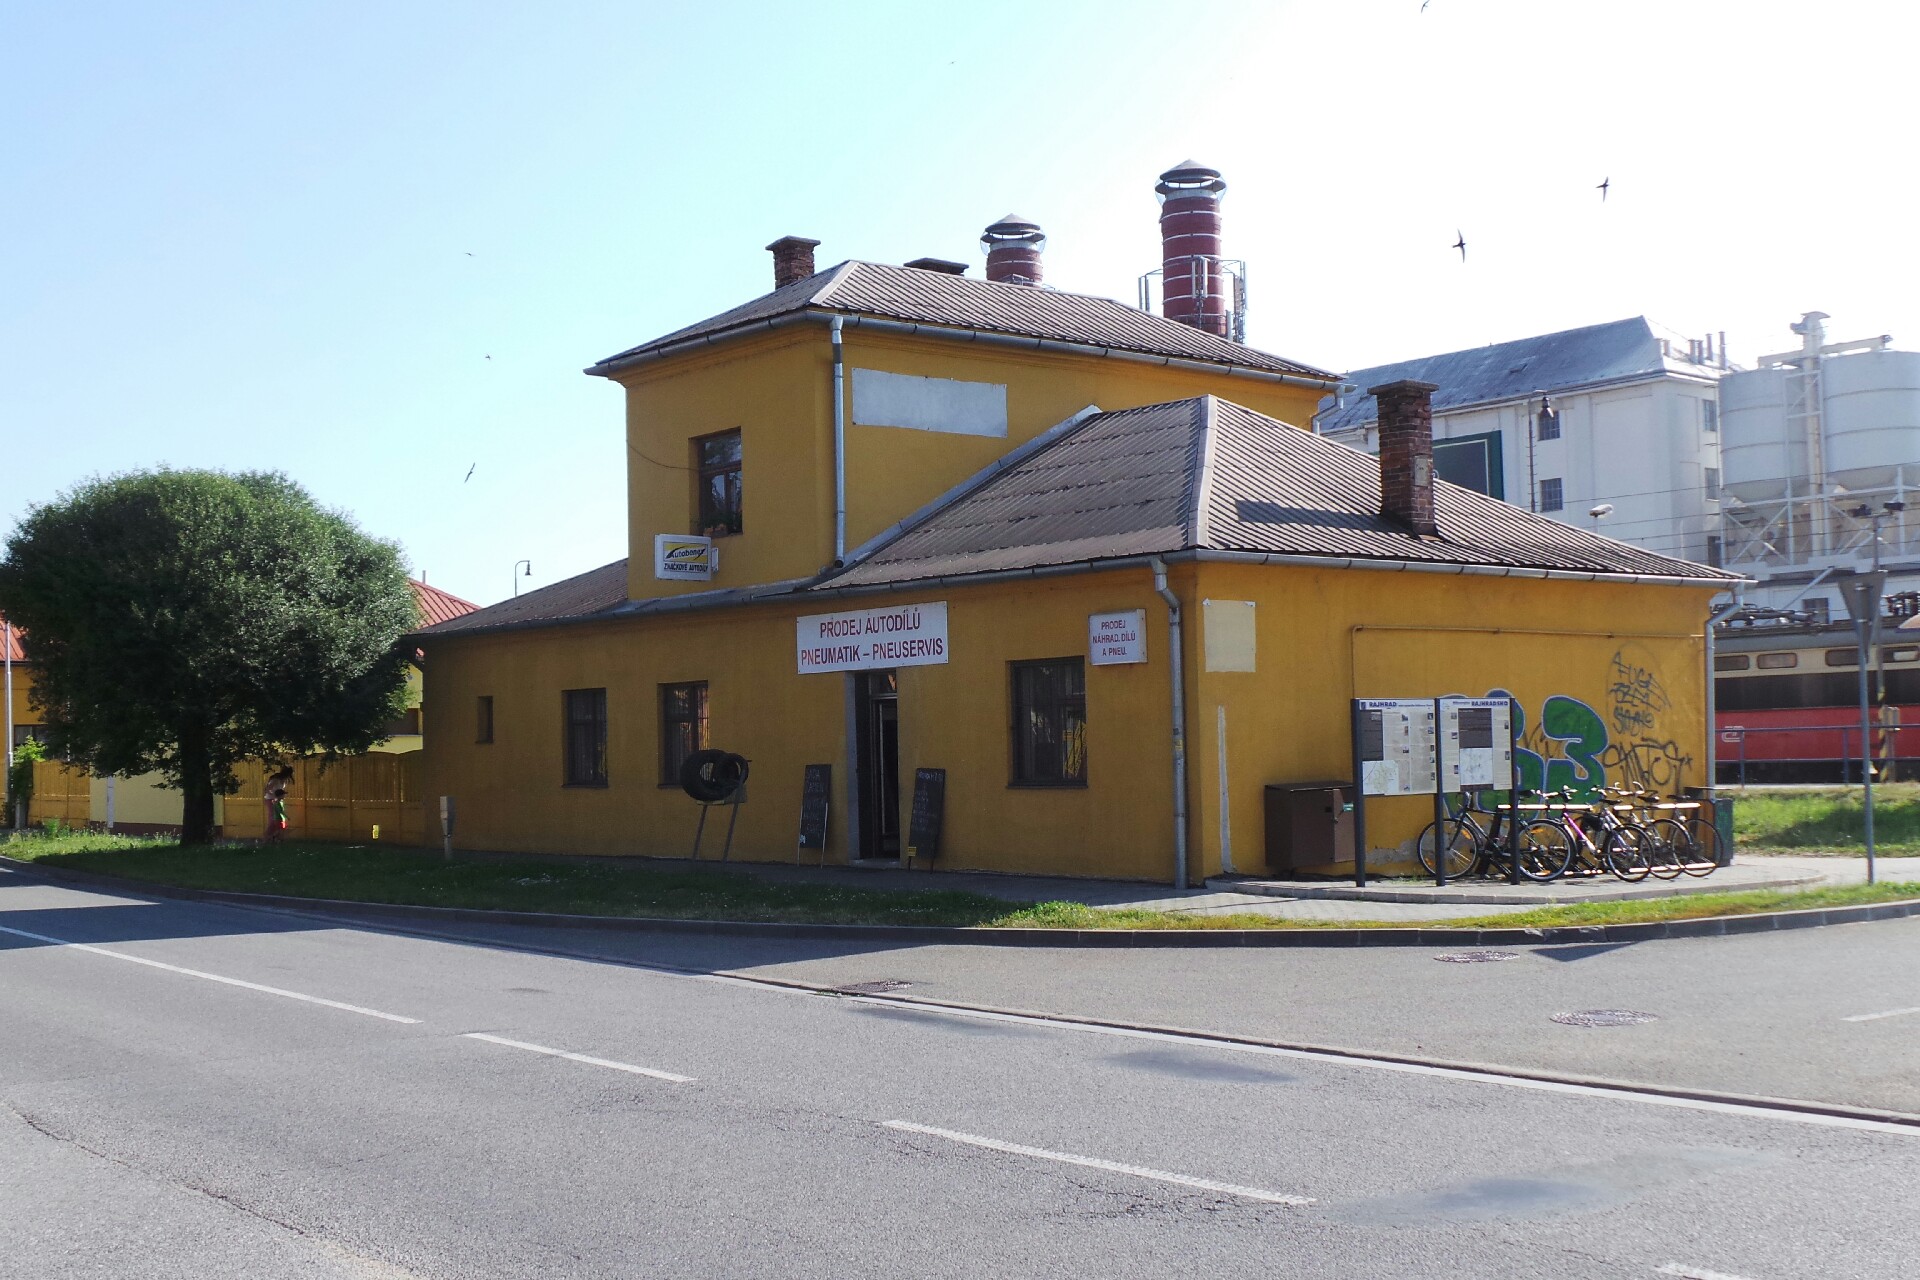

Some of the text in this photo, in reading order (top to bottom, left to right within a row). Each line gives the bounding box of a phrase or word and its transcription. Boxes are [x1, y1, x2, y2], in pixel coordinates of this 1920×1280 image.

[820, 607, 921, 638] PRODEJ AUTODÍLŮ
[1101, 620, 1126, 630] PRODEJ
[1121, 631, 1136, 642] DÍLŮ
[801, 645, 861, 666] PNEUMATIK
[873, 638, 943, 660] PNEUSERVIS
[1102, 648, 1107, 656] A
